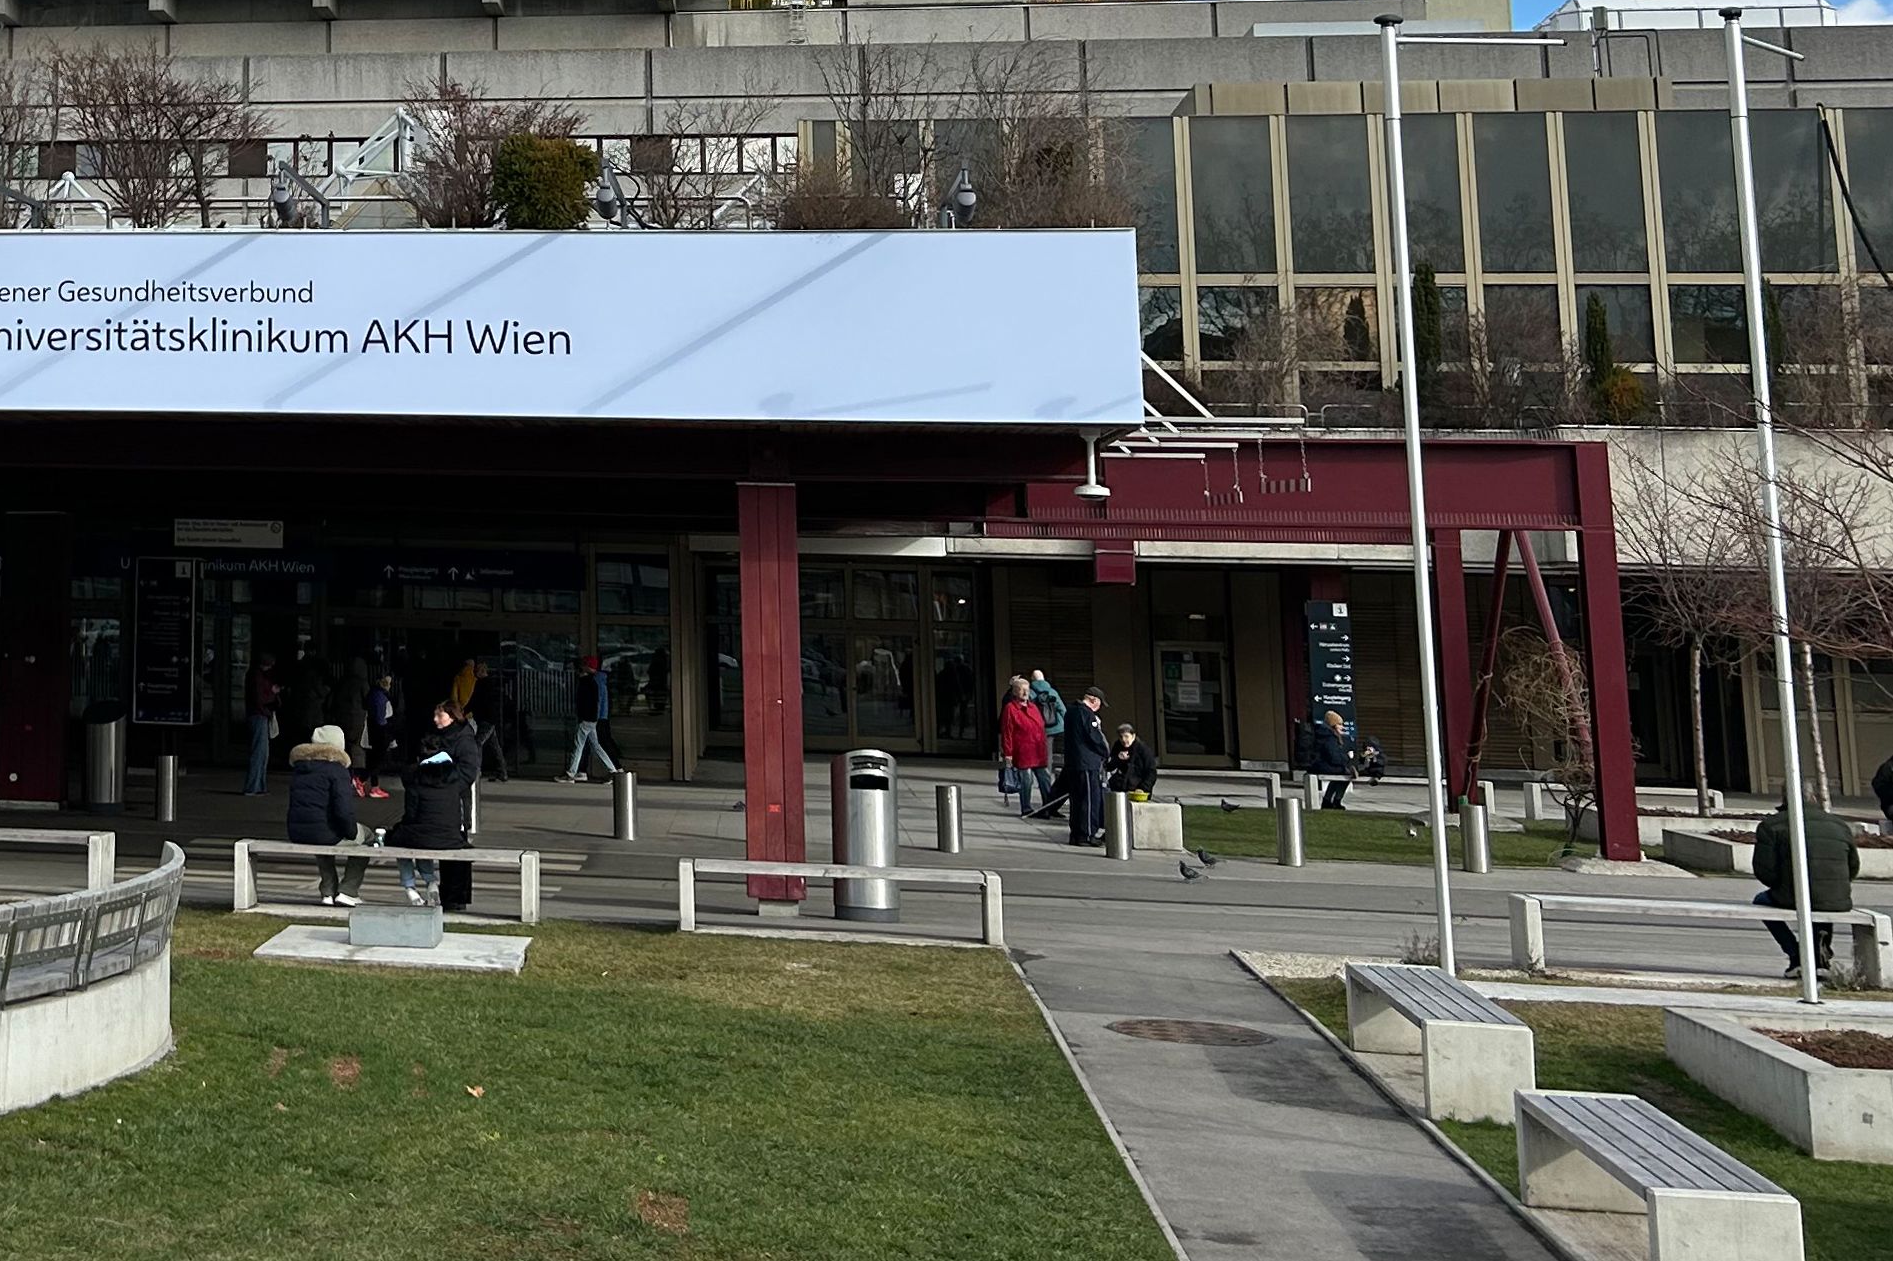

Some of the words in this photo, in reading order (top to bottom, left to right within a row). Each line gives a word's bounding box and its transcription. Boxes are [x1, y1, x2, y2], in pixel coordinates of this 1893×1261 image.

[57, 279, 314, 303] Gesundheitsverbund
[361, 319, 453, 354] AKH
[465, 320, 571, 355] Wien
[249, 559, 279, 572] AKH
[282, 561, 316, 573] Wien
